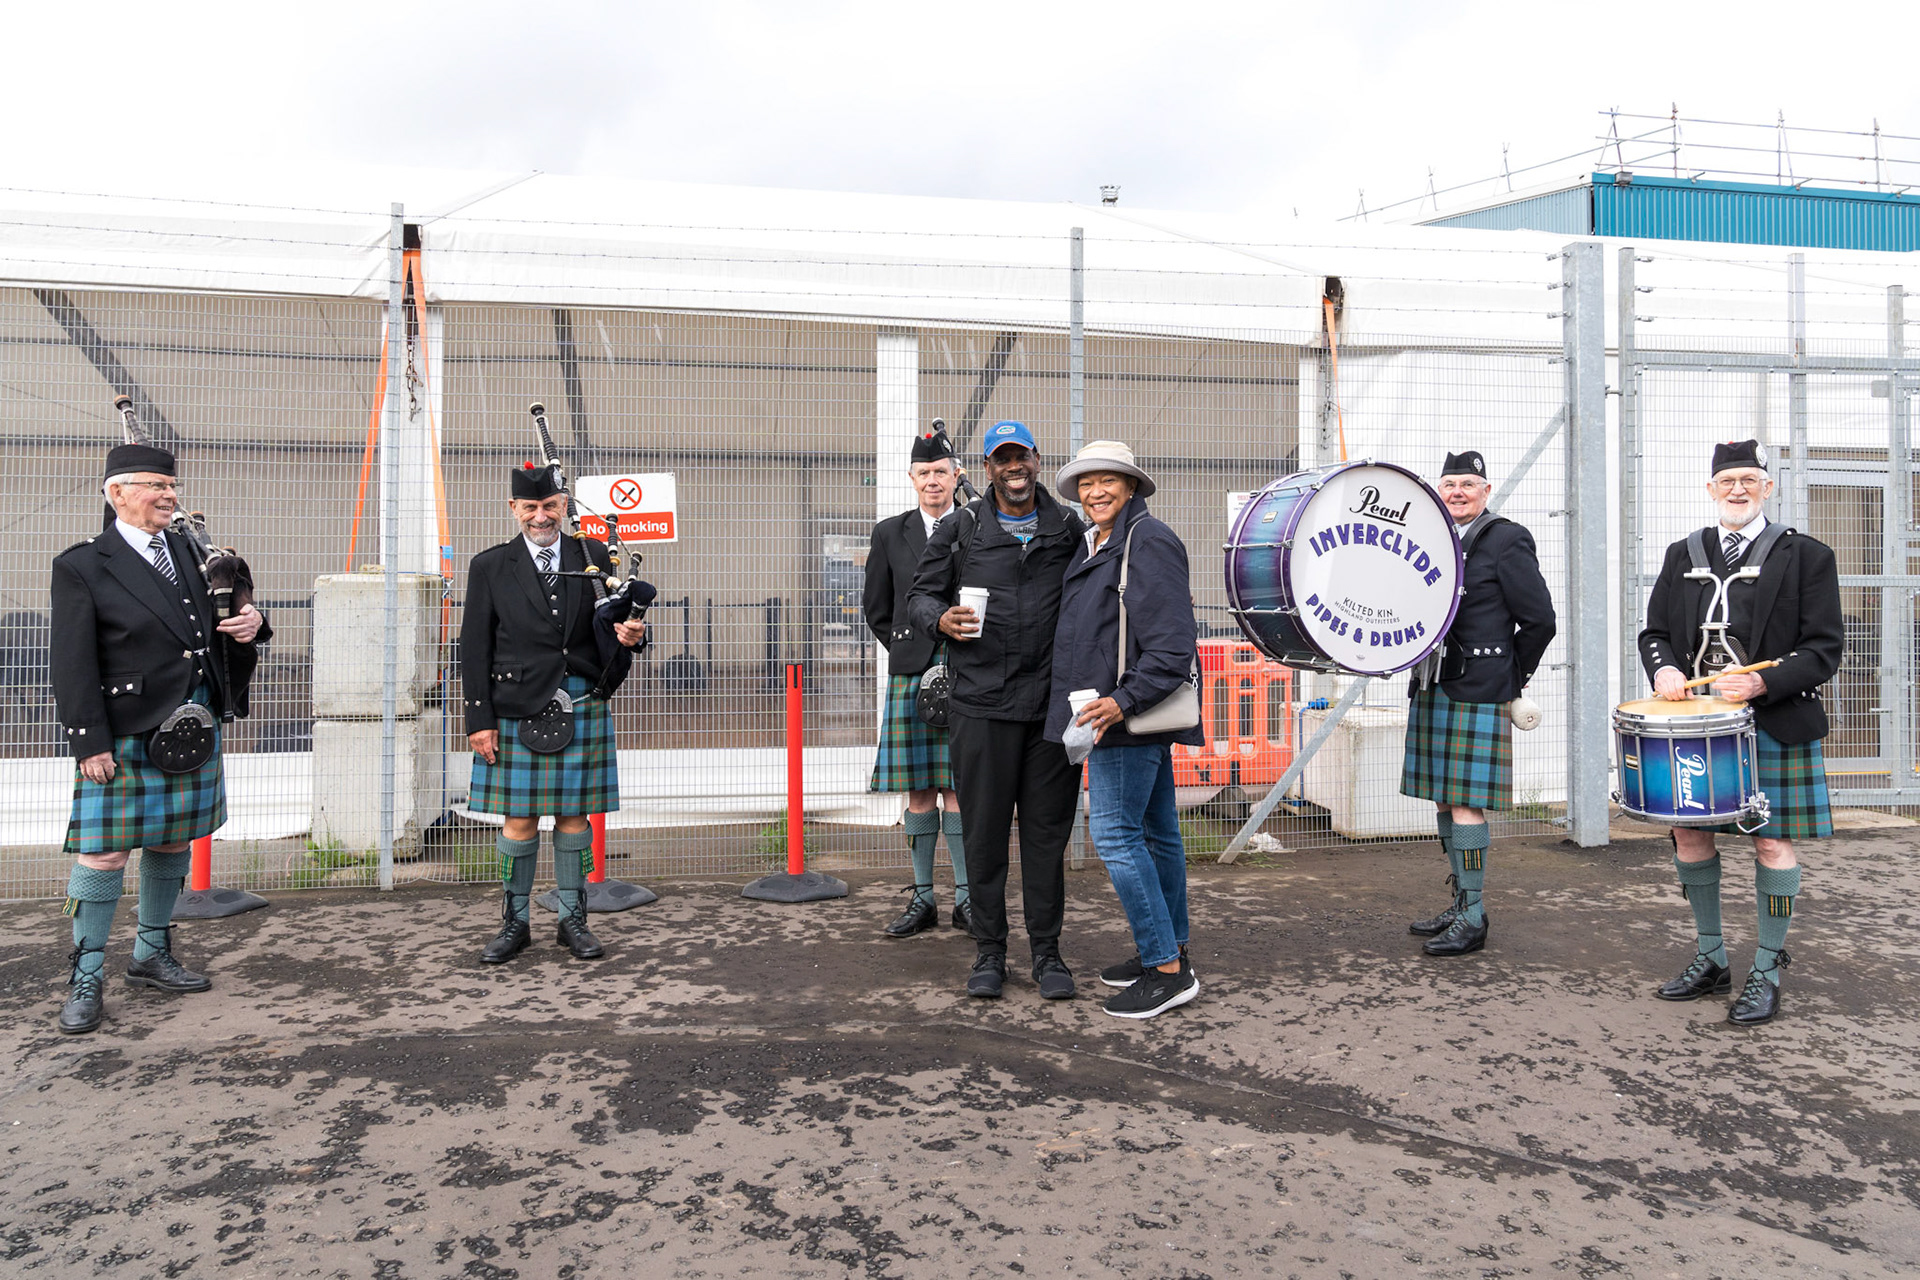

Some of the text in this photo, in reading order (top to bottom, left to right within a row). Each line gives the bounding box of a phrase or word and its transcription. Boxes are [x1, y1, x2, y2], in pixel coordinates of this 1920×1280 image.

[1349, 485, 1412, 522] Pearl
[586, 521, 668, 535] No moking
[1309, 523, 1442, 587] INVERCLYDE
[1305, 593, 1426, 647] PIPES & DRUMS
[1334, 601, 1401, 625] HIGHLAND OUTFITTERS
[1343, 597, 1393, 617] KILTED KIN
[1675, 746, 1706, 810] Pearl
